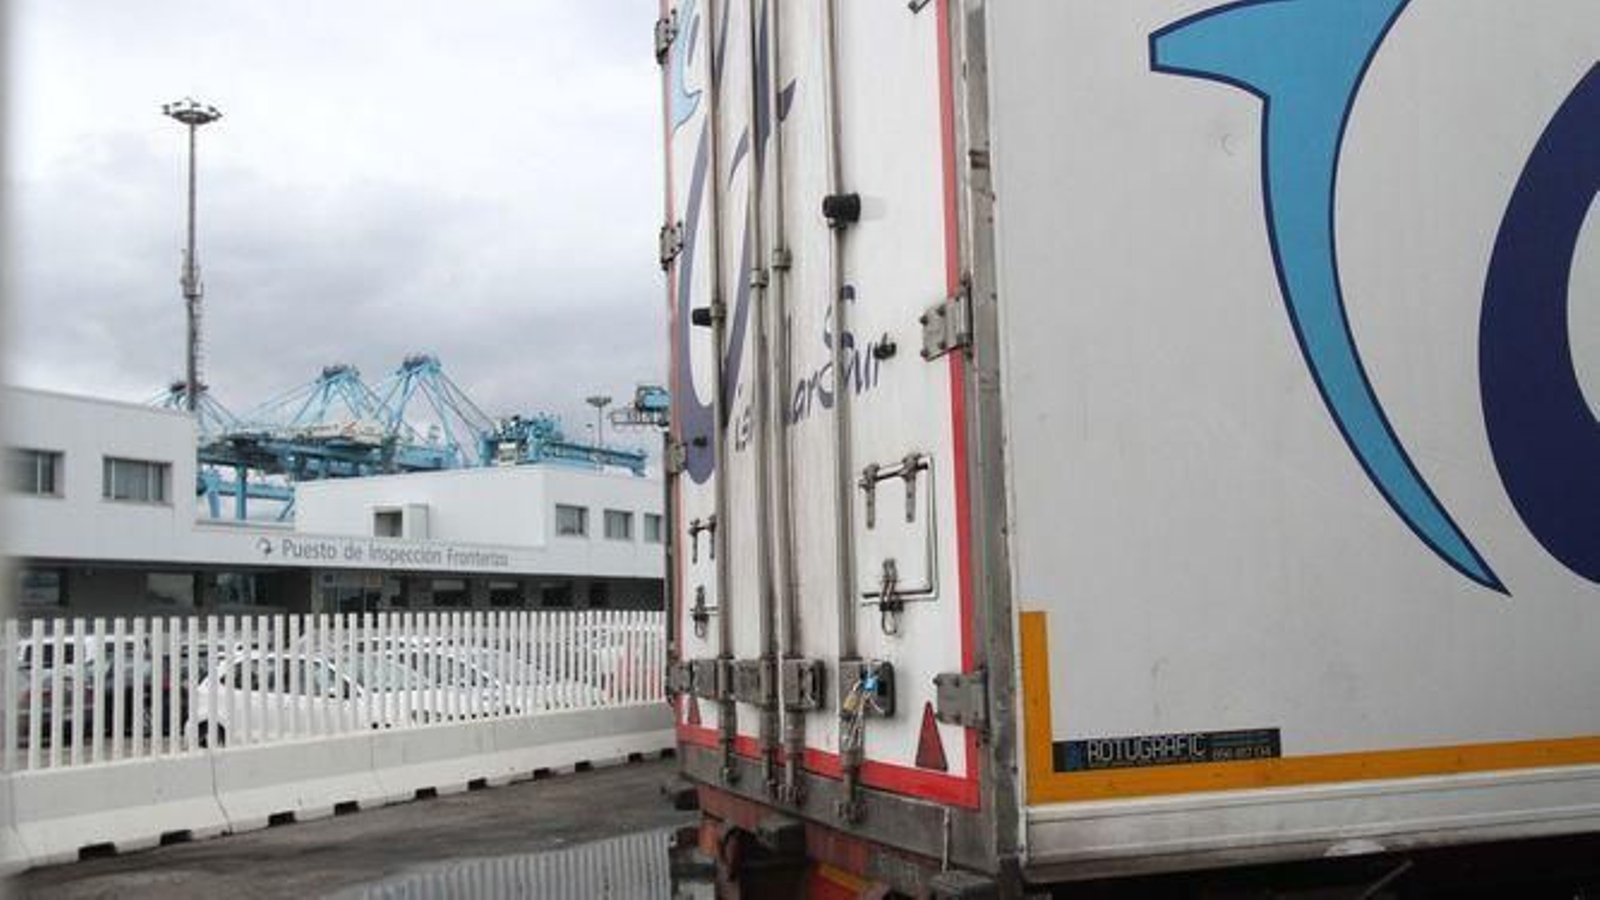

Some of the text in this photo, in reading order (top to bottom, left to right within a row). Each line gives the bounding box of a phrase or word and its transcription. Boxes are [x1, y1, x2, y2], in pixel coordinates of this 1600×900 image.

[281, 538, 338, 560] Puesto
[344, 541, 363, 560] de
[368, 541, 442, 565] Inspección
[1086, 733, 1206, 762] ROTUGRAFIC
